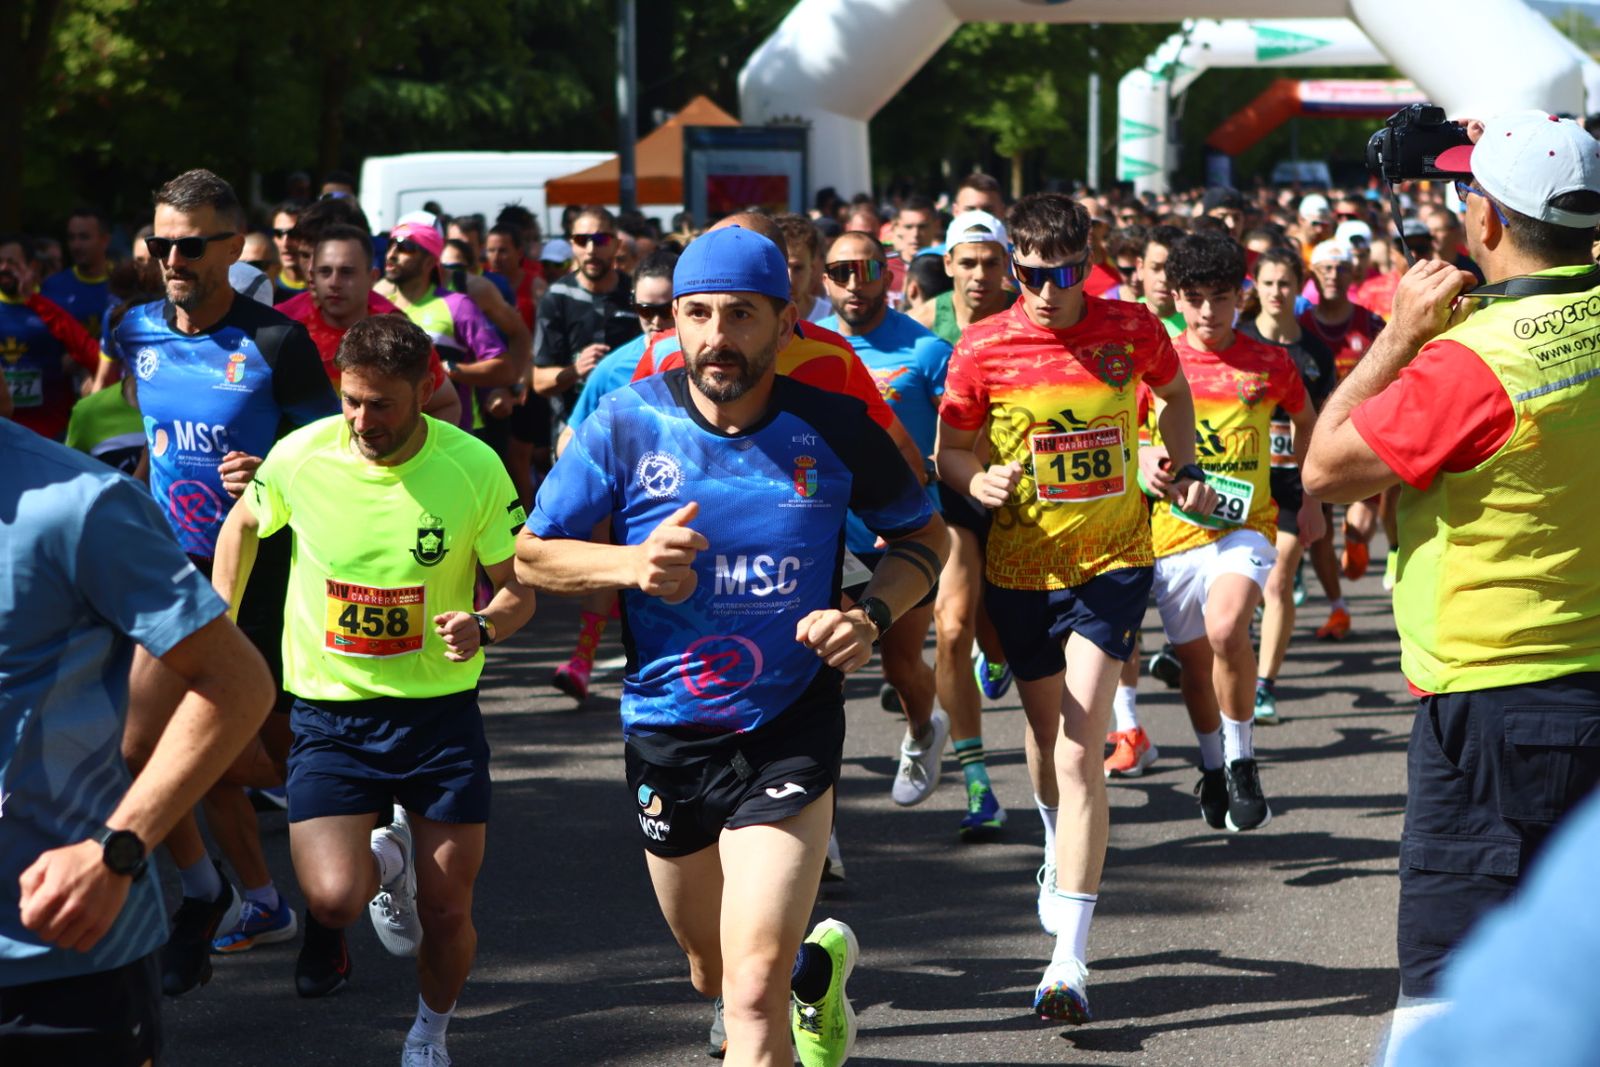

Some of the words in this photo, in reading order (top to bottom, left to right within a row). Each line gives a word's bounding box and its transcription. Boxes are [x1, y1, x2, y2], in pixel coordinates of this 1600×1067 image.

[173, 419, 229, 453] MSC
[1058, 440, 1100, 451] CARRERA
[1050, 449, 1112, 482] 158
[1213, 493, 1245, 520] 29
[327, 581, 350, 598] XIV
[714, 554, 800, 597] MSC
[351, 593, 397, 605] CARRERA
[338, 604, 410, 637] 458
